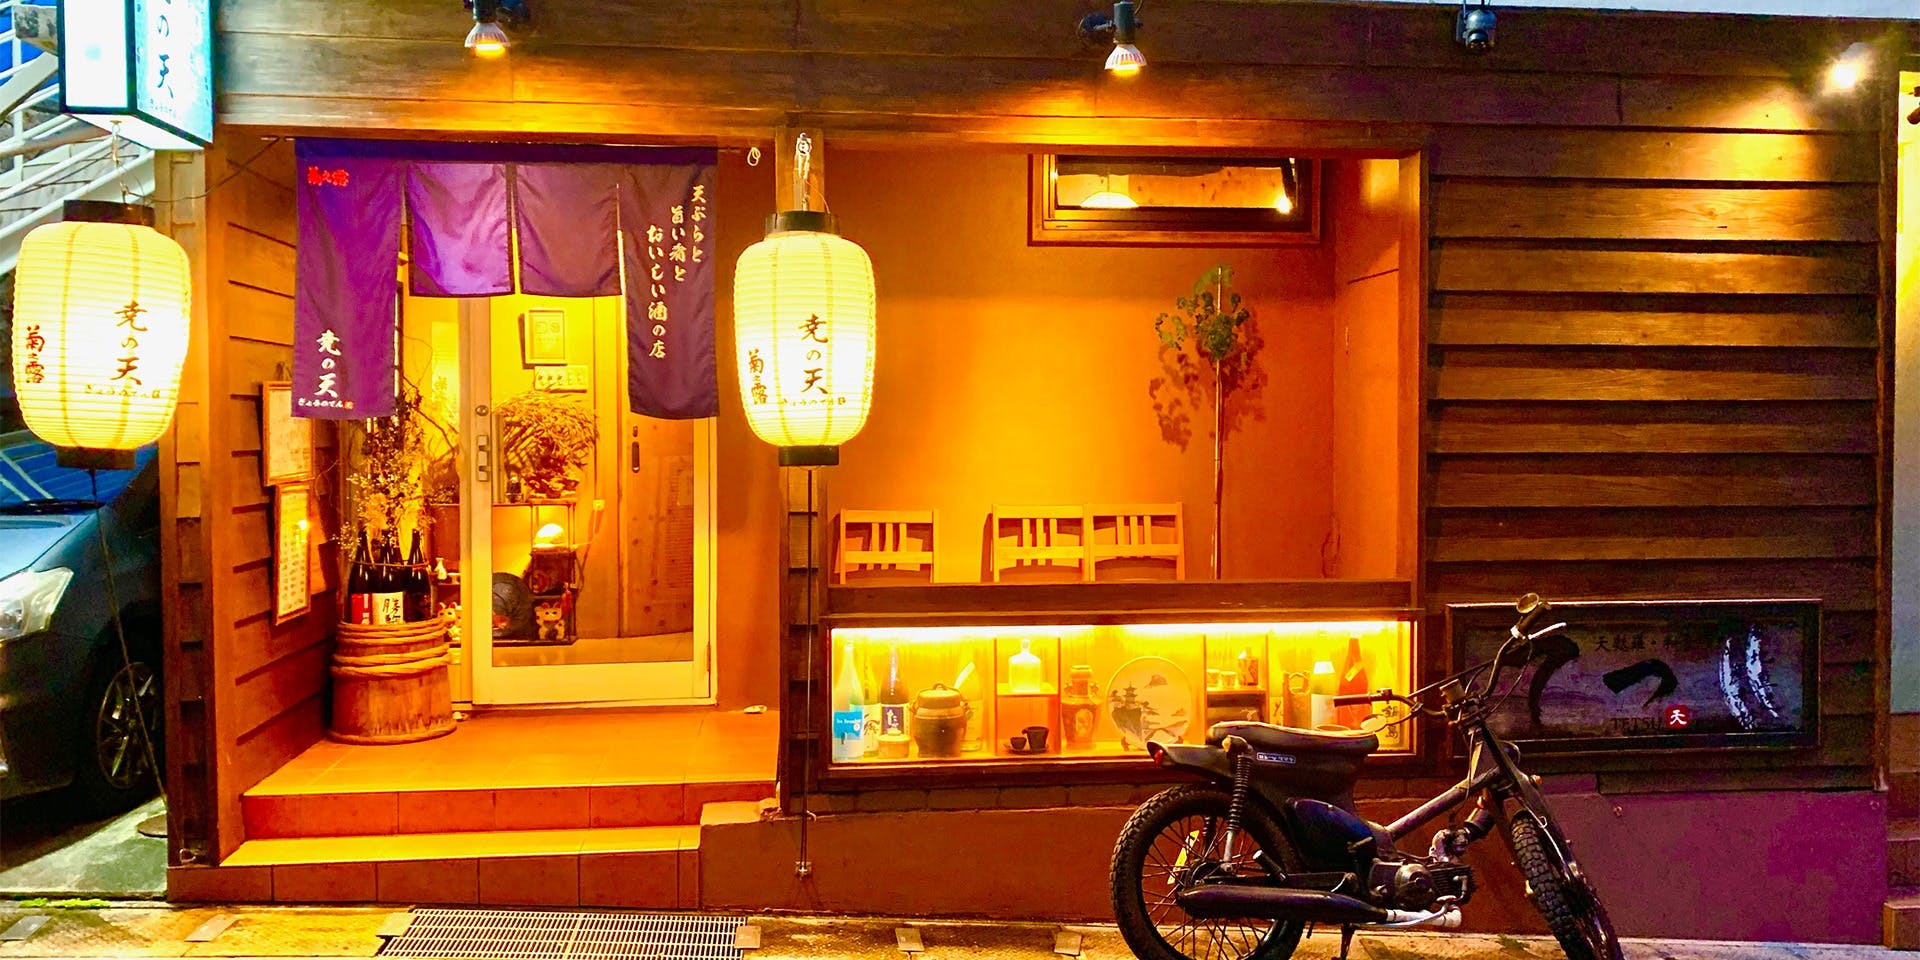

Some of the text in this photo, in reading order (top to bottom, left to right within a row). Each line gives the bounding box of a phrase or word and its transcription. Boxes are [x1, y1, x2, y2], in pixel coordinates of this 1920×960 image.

[157, 0, 174, 99] の天
[646, 224, 668, 358] おいしい酒の店
[1669, 709, 1688, 726] 天
